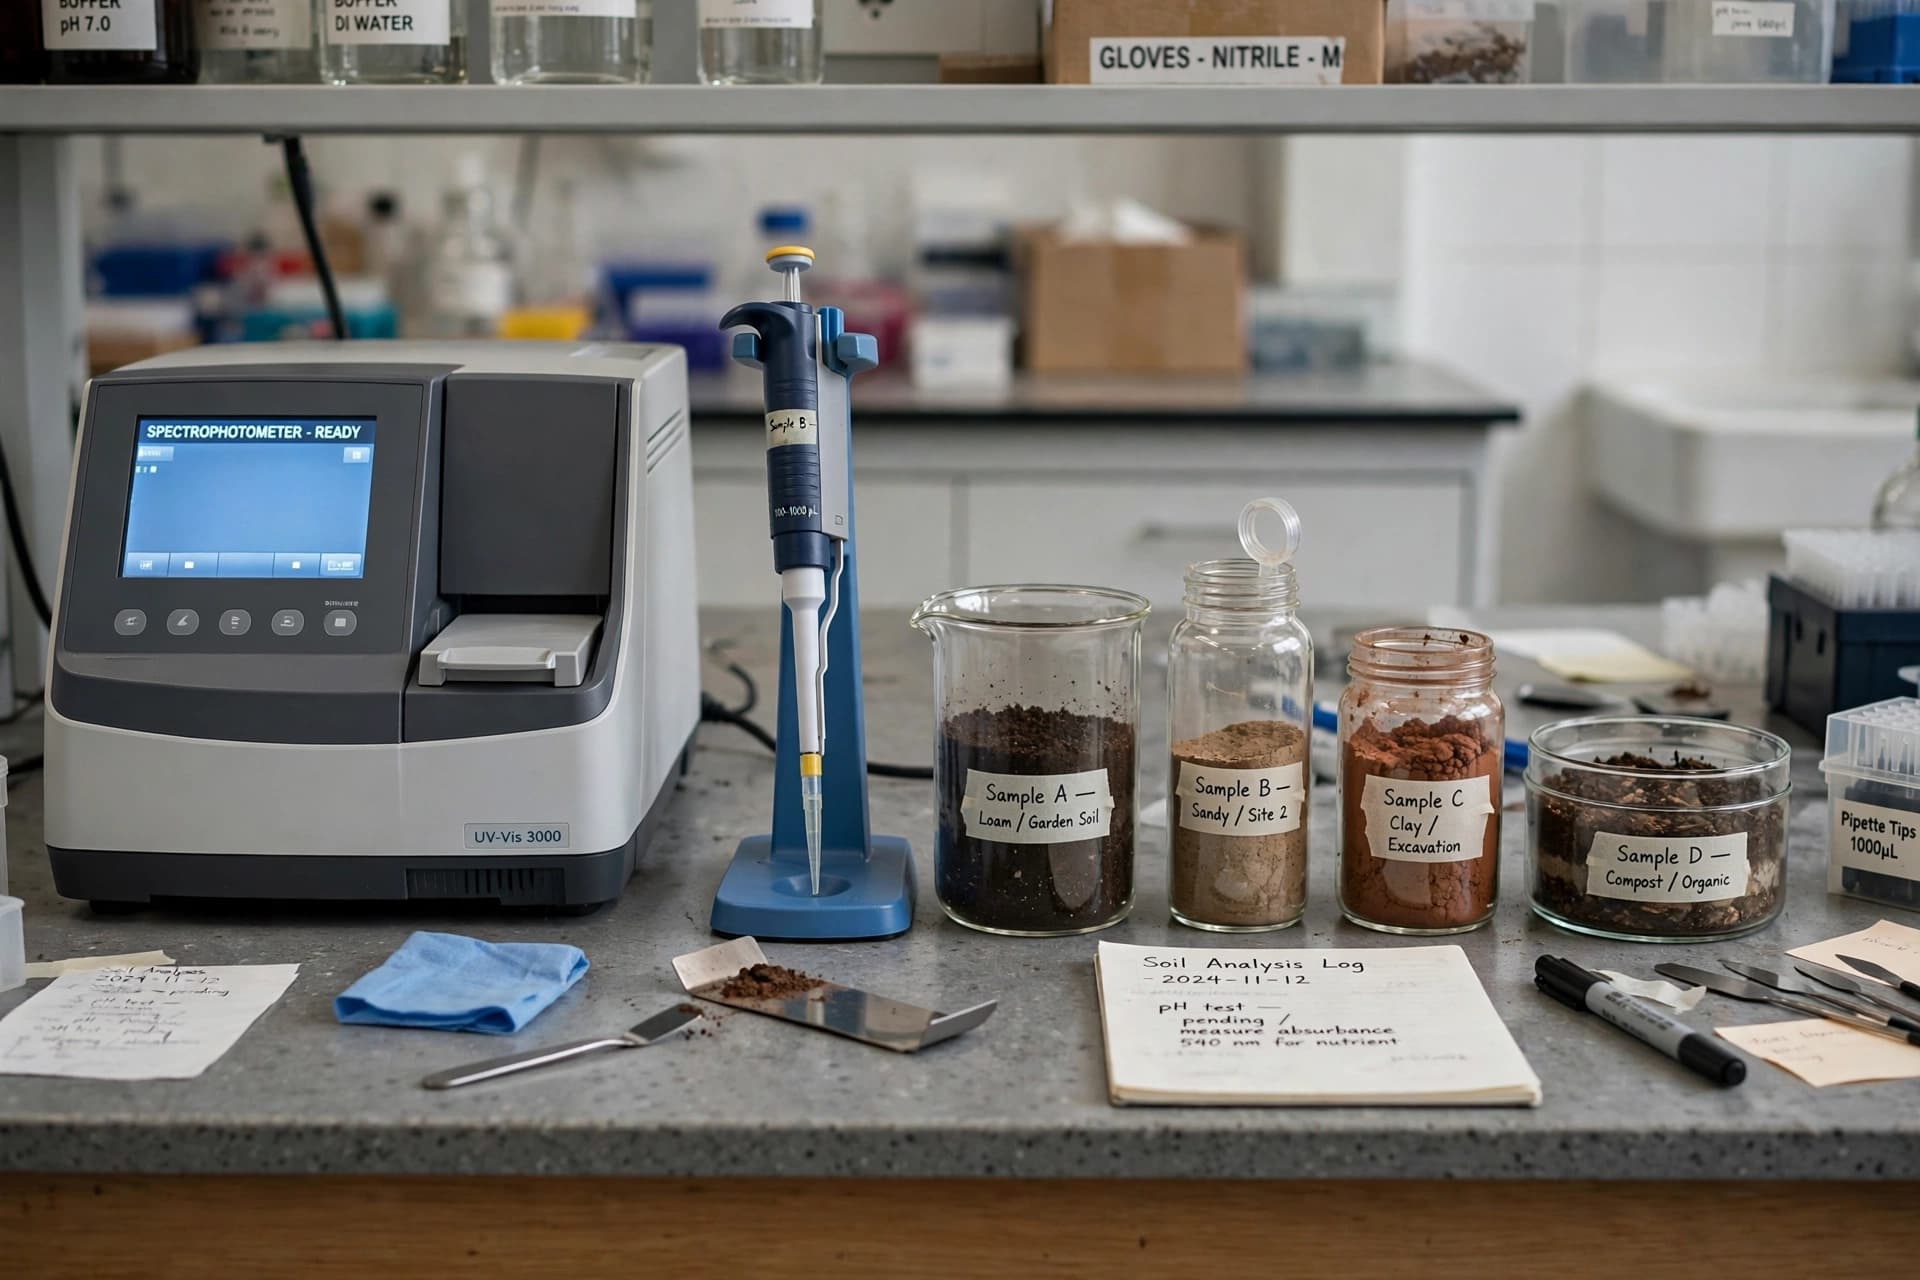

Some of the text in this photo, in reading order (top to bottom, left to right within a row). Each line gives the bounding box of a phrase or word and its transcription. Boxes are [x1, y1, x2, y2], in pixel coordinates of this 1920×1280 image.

[61, 16, 111, 36] pH 7.0
[335, 15, 414, 31] DI WATER
[1100, 46, 1190, 69] GLOVES
[1212, 46, 1300, 68] NITRILE
[1322, 46, 1341, 67] M
[147, 425, 302, 439] SPECTROPHOTOMETER
[315, 425, 361, 439] READY
[799, 416, 807, 429] B
[986, 783, 1045, 810] Sample
[1054, 784, 1067, 803] A
[1195, 776, 1250, 802] Sample
[1259, 778, 1271, 797] B
[1384, 788, 1464, 814] Sample C
[979, 808, 1099, 832] Loam / Garden Soil
[1192, 803, 1288, 827] Sandy / Site 2
[1390, 815, 1438, 838] Clay /
[1841, 810, 1917, 841] Pipette Tips
[474, 830, 562, 843] UV-Vis 3000
[1388, 837, 1461, 854] Excavation
[1850, 835, 1898, 860] 1000µL
[1617, 845, 1679, 870] Sample
[1689, 846, 1702, 864] D
[1606, 870, 1730, 894] Compost / Organic
[1143, 956, 1365, 973] Soil Analysis Log
[1159, 1001, 1188, 1015] pH
[1205, 1001, 1246, 1012] test
[1183, 1016, 1264, 1027] pending
[1275, 1037, 1304, 1046] for
[1316, 1038, 1398, 1046] nutrient
